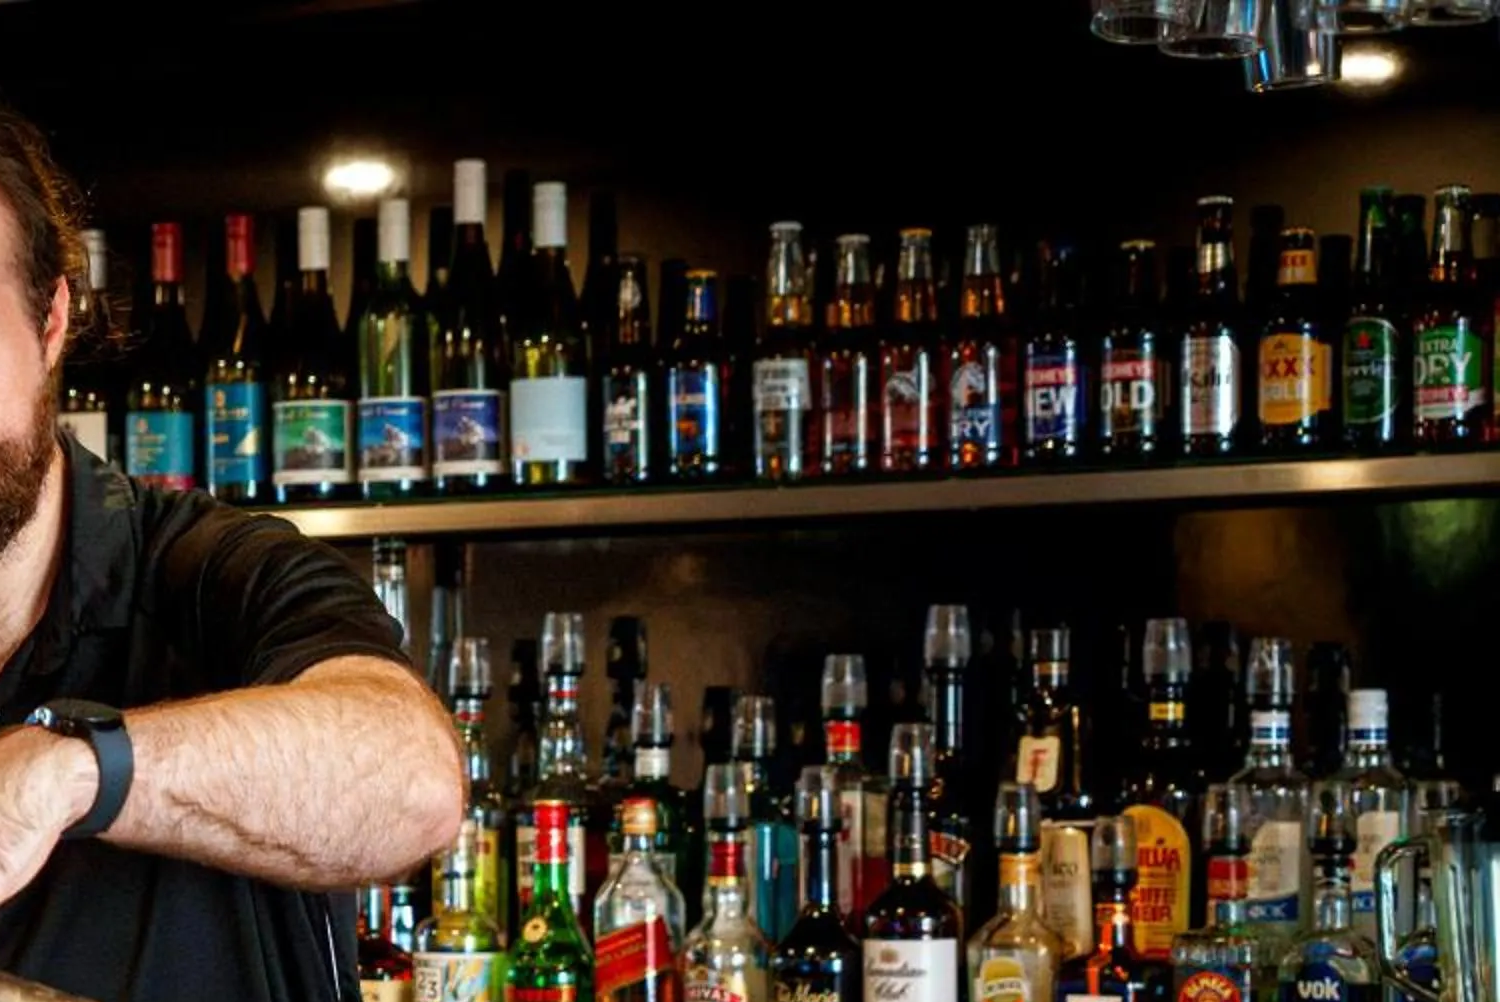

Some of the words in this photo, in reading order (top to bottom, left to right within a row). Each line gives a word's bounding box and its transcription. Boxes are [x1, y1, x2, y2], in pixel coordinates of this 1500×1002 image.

[1263, 356, 1316, 379] XXX
[1414, 352, 1472, 386] DRY
[1101, 380, 1155, 410] OLD
